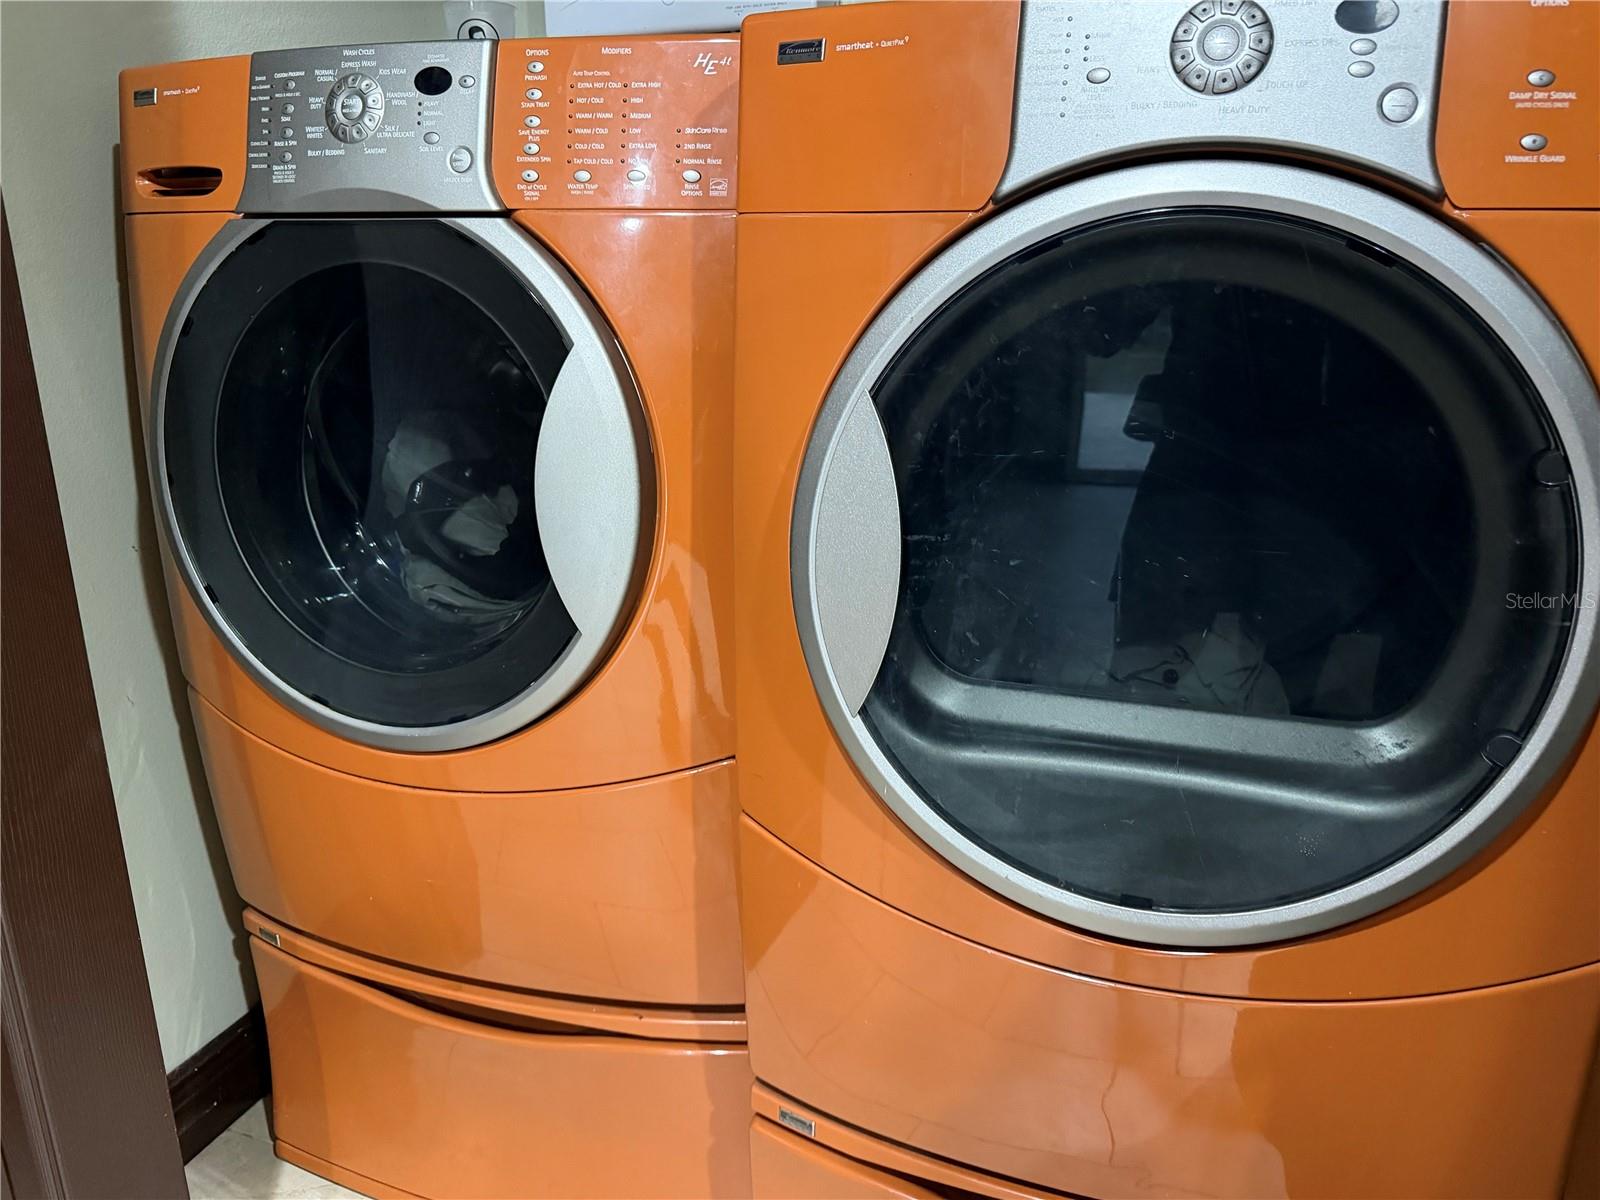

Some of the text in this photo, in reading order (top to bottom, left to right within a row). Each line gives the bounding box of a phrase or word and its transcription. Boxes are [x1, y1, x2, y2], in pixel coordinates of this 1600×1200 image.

[835, 41, 873, 52] smartheat
[526, 49, 549, 57] OPTIONS
[602, 47, 632, 55] MODIFIERS
[1539, 155, 1566, 163] GUARD
